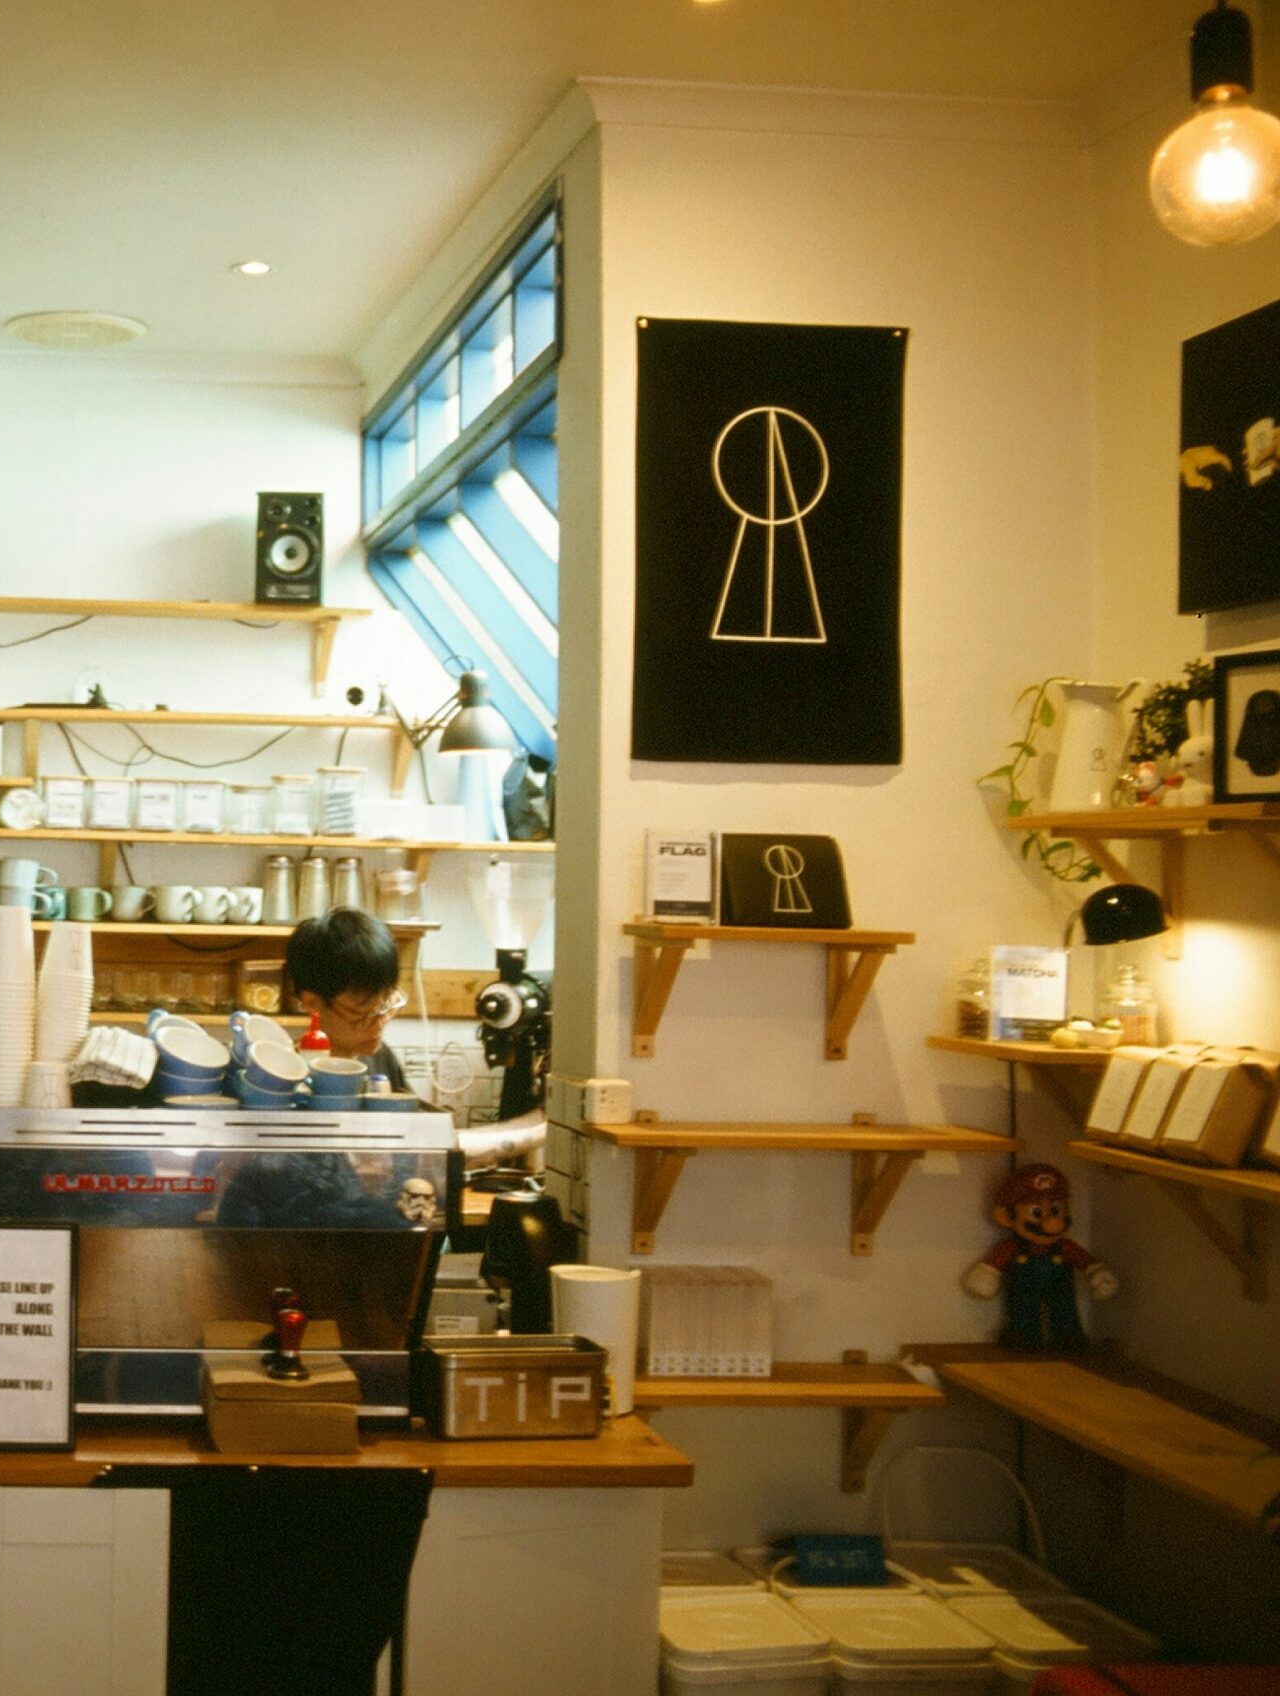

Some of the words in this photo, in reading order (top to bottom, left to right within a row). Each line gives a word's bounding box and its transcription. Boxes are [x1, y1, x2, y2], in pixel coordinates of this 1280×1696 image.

[659, 846, 707, 857] FLAG
[15, 1282, 37, 1294] LINE
[40, 1283, 54, 1295] UP
[23, 1324, 54, 1337] WALL
[24, 1380, 43, 1391] YOU
